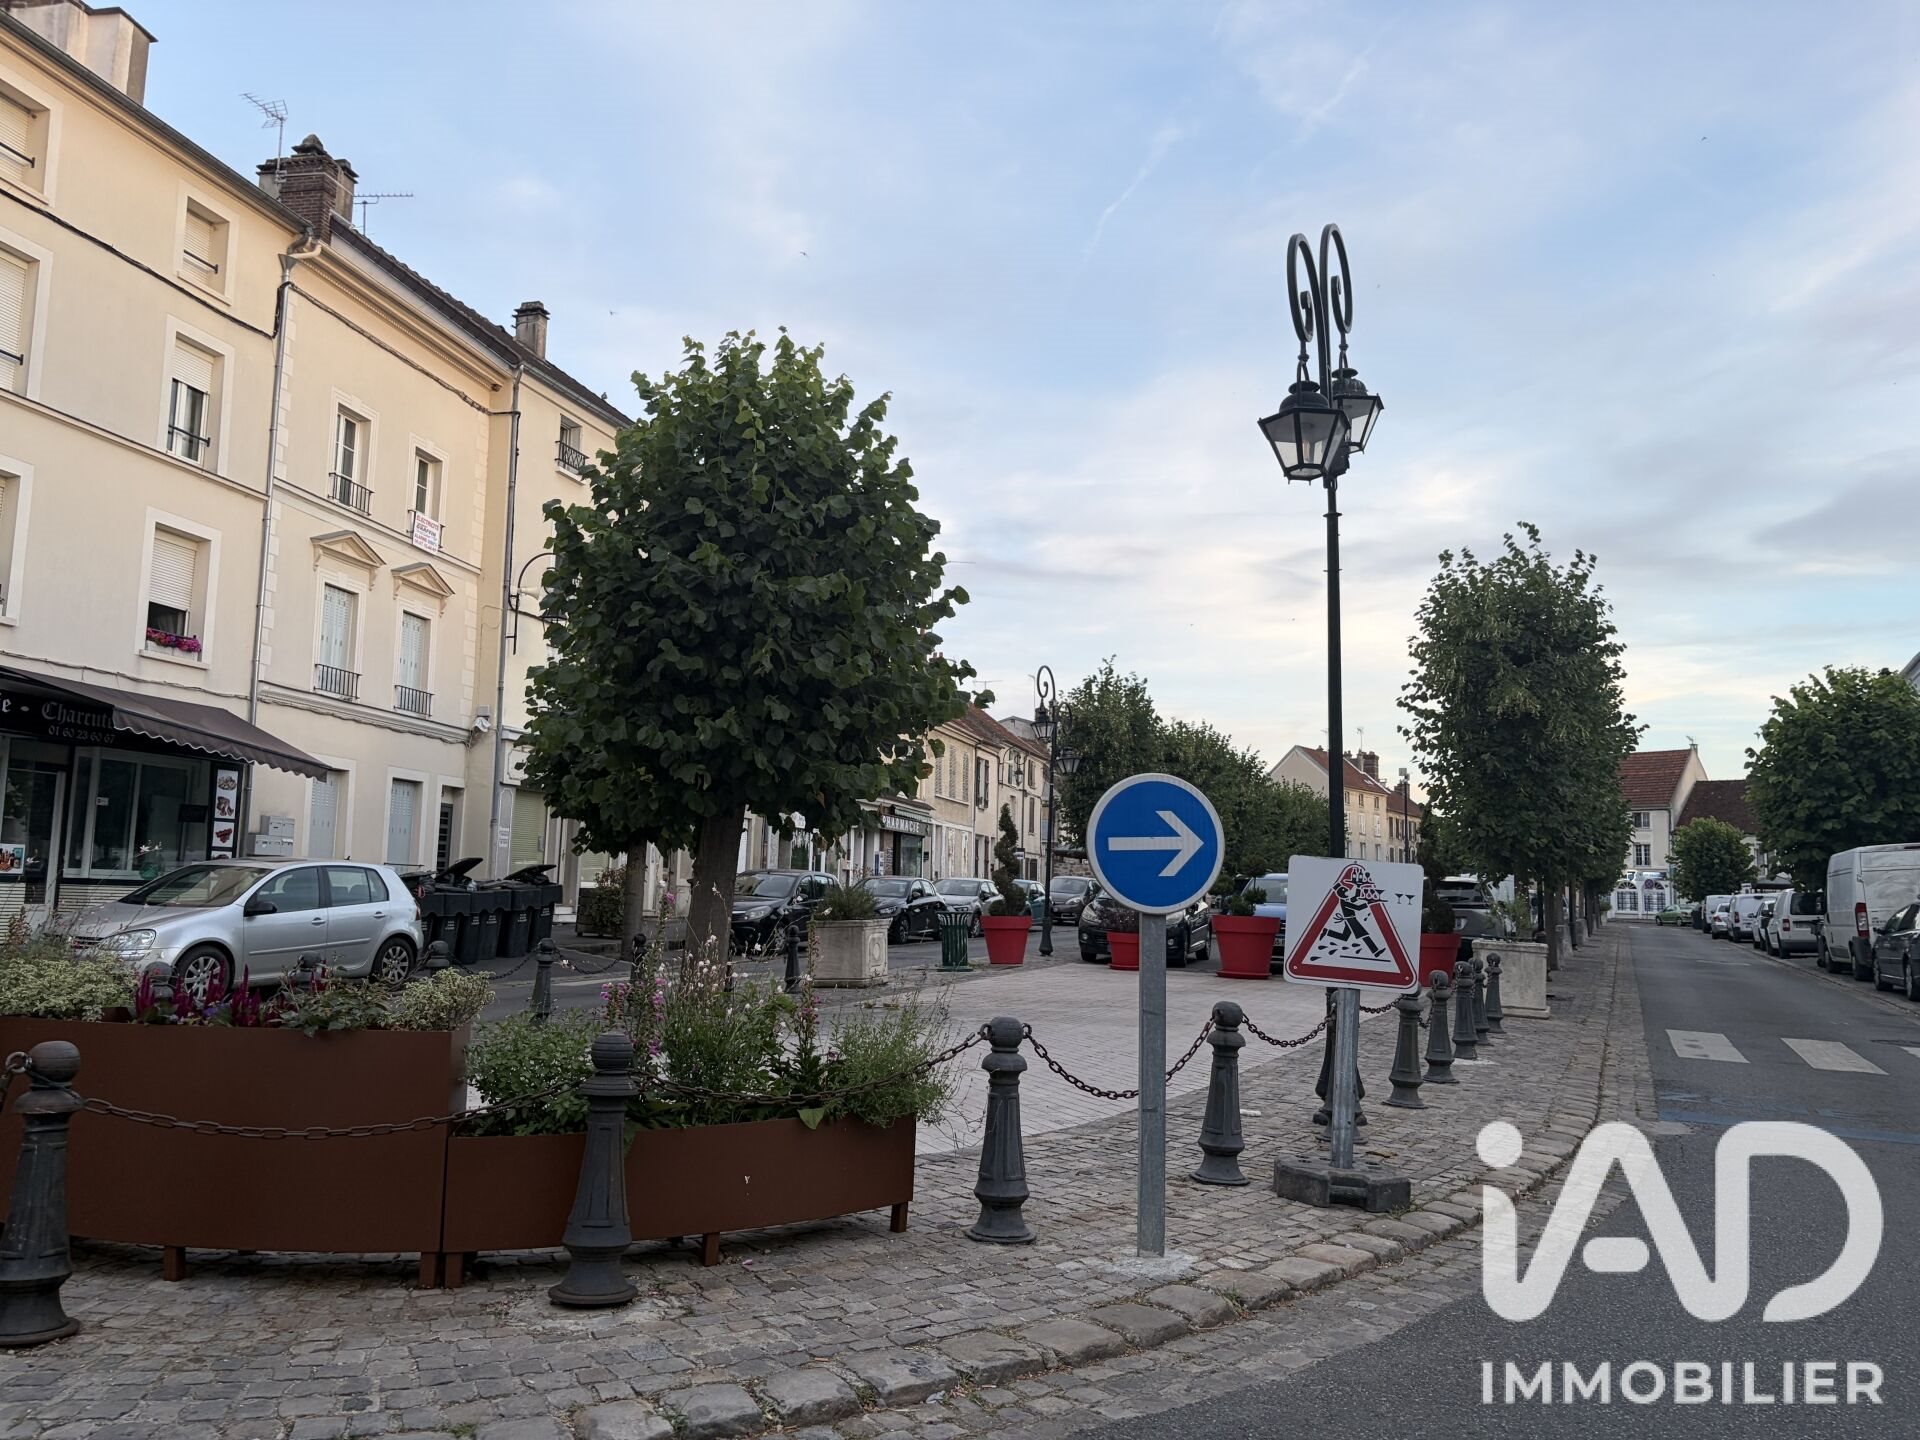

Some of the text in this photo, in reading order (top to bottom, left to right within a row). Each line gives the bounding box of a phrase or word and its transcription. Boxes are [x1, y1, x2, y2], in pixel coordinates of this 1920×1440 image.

[48, 725, 59, 736] 01
[62, 727, 75, 738] 60
[76, 729, 88, 740] 23
[882, 815, 919, 833] PHARMACIE
